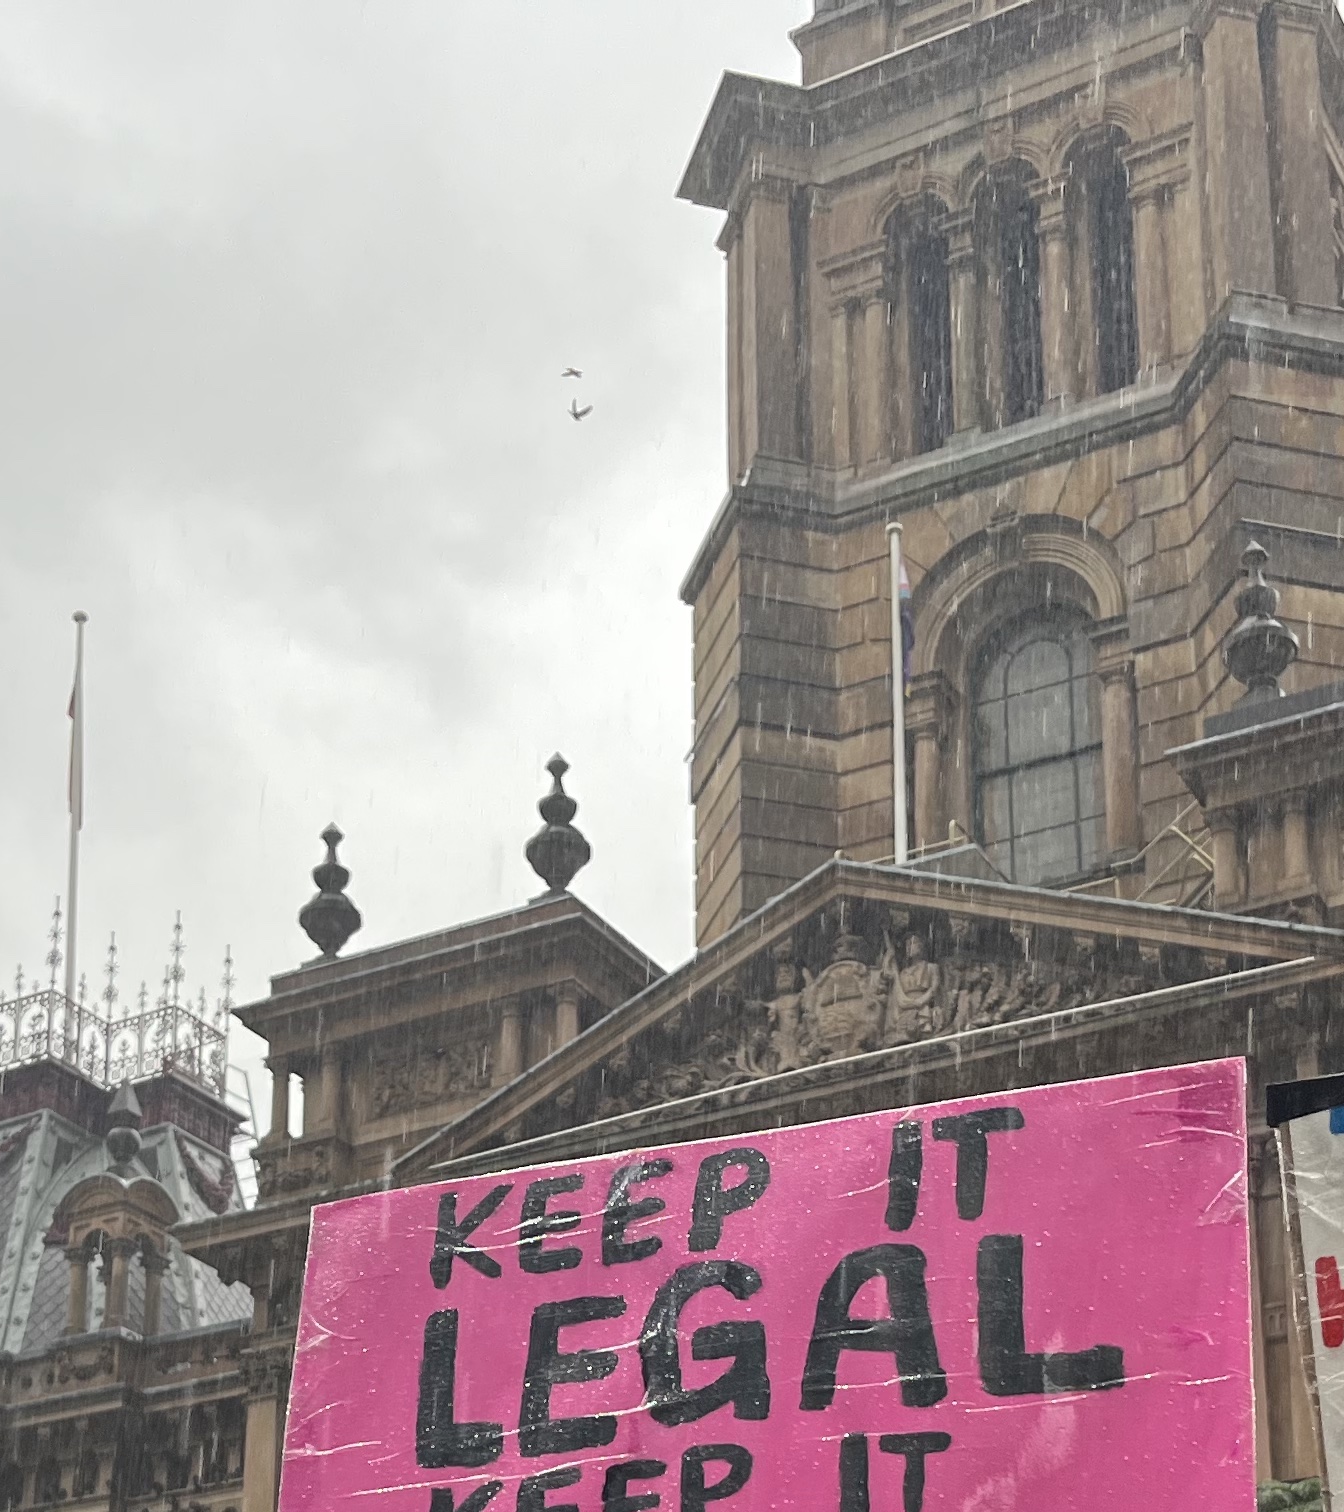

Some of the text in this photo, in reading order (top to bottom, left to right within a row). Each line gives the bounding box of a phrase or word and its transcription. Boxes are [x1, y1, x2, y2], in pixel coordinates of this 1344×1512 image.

[429, 1106, 1023, 1289] KEEP IT
[416, 1235, 1125, 1468] LEGAL
